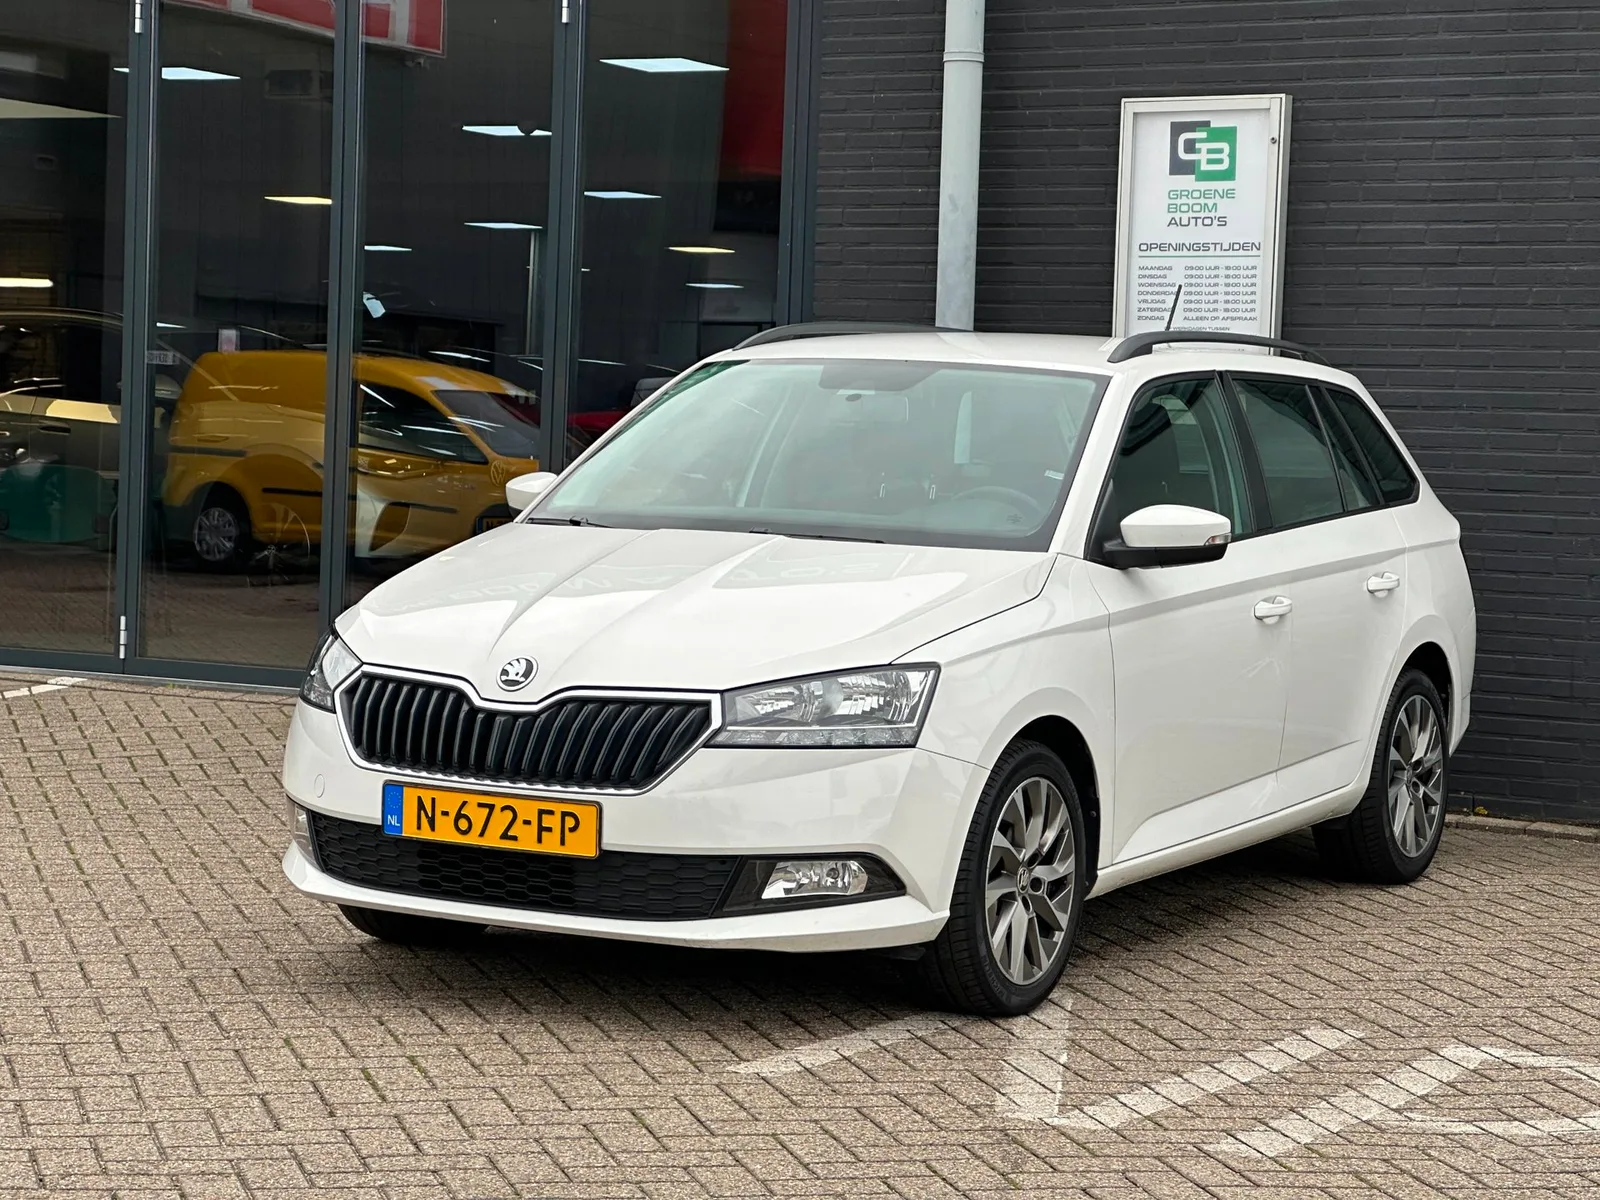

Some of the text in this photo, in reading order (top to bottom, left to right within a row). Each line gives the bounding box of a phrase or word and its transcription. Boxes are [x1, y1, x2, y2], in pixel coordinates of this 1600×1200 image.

[1168, 189, 1236, 200] GROENE
[1167, 203, 1218, 213] BOOM
[1167, 215, 1227, 227] AUTO'S
[1138, 242, 1261, 252] OPENINGSTIJDEN
[387, 814, 400, 826] NL
[416, 795, 580, 846] N-672-FP
